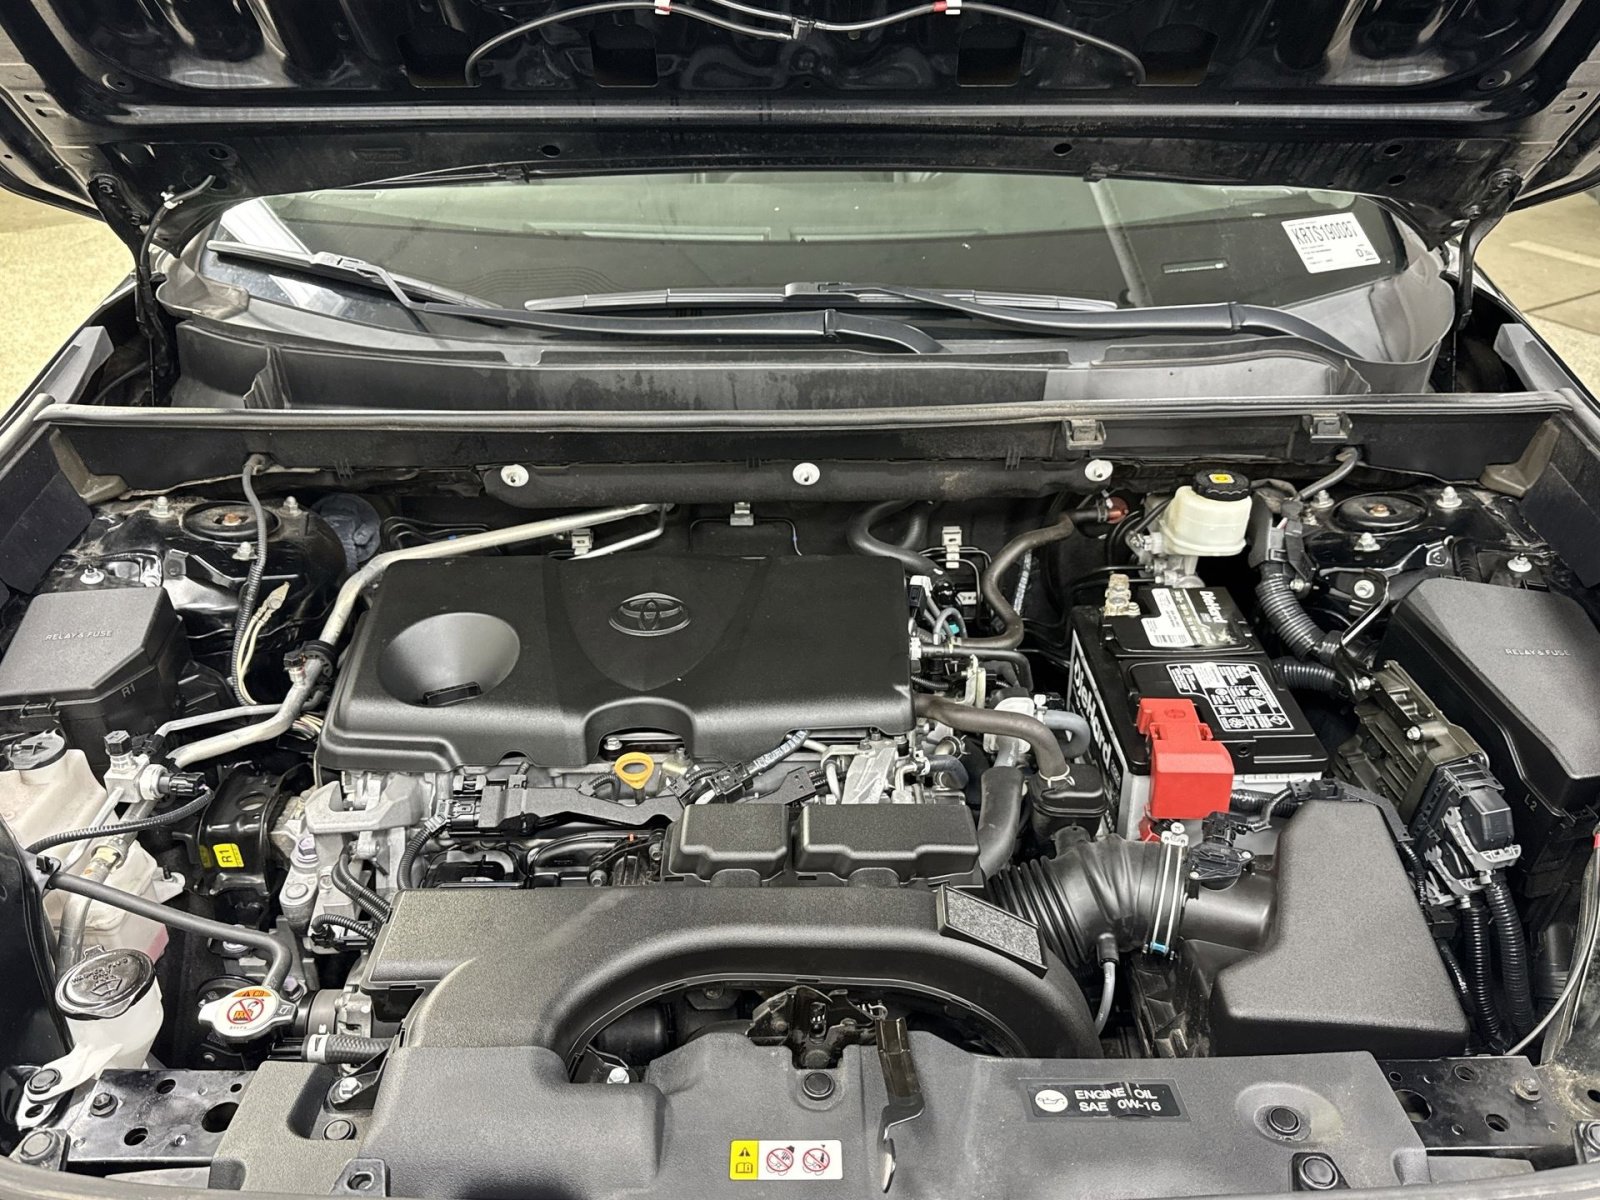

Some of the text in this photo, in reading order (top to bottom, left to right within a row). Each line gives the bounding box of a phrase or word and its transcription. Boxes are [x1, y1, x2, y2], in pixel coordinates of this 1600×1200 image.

[1199, 590, 1229, 624] DieHard
[86, 630, 113, 638] FUSE
[121, 683, 136, 699] R1
[1073, 656, 1112, 772] DieHard
[1524, 793, 1537, 811] L2
[219, 849, 233, 863] R1
[1074, 1087, 1158, 1100] ENGINE OIL
[1079, 1098, 1162, 1112] SAE 0W-16
